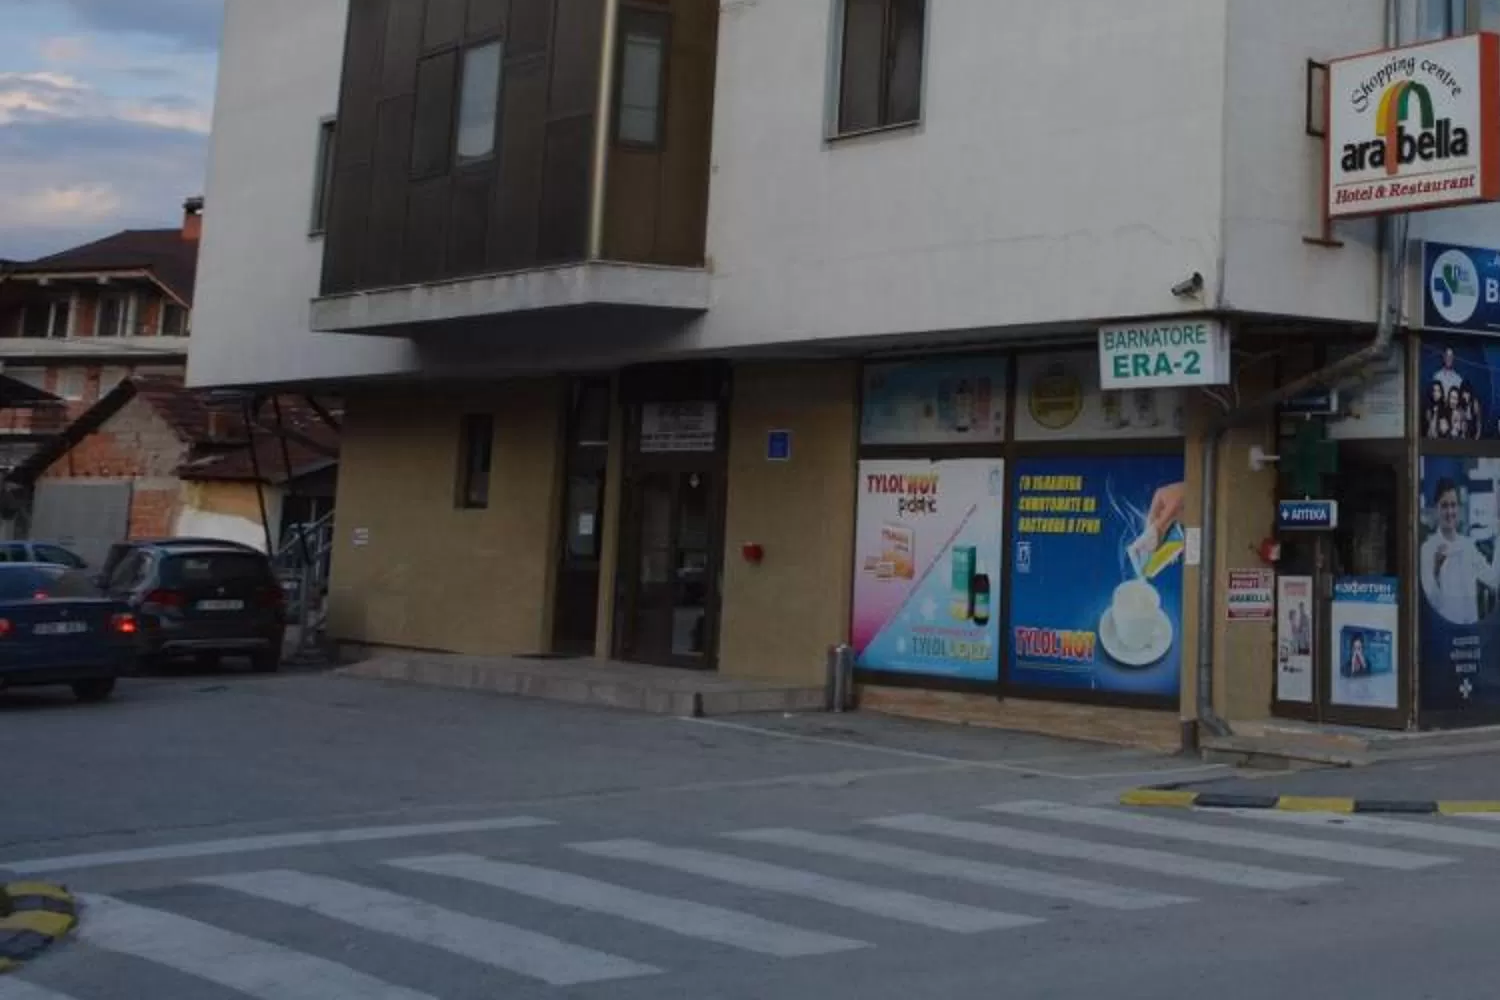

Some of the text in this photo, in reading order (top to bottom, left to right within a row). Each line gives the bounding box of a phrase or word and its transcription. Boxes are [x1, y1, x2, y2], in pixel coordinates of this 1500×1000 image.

[1351, 56, 1463, 113] Shopping centre
[1336, 173, 1475, 204] Hotel & Restaurant
[1103, 323, 1208, 351] BARNATORE
[1112, 348, 1201, 378] ERA-2
[867, 474, 905, 494] TYLOL
[1291, 507, 1328, 521] АПТЕКА
[1015, 626, 1059, 659] TYLOL
[1060, 629, 1096, 662] HOT
